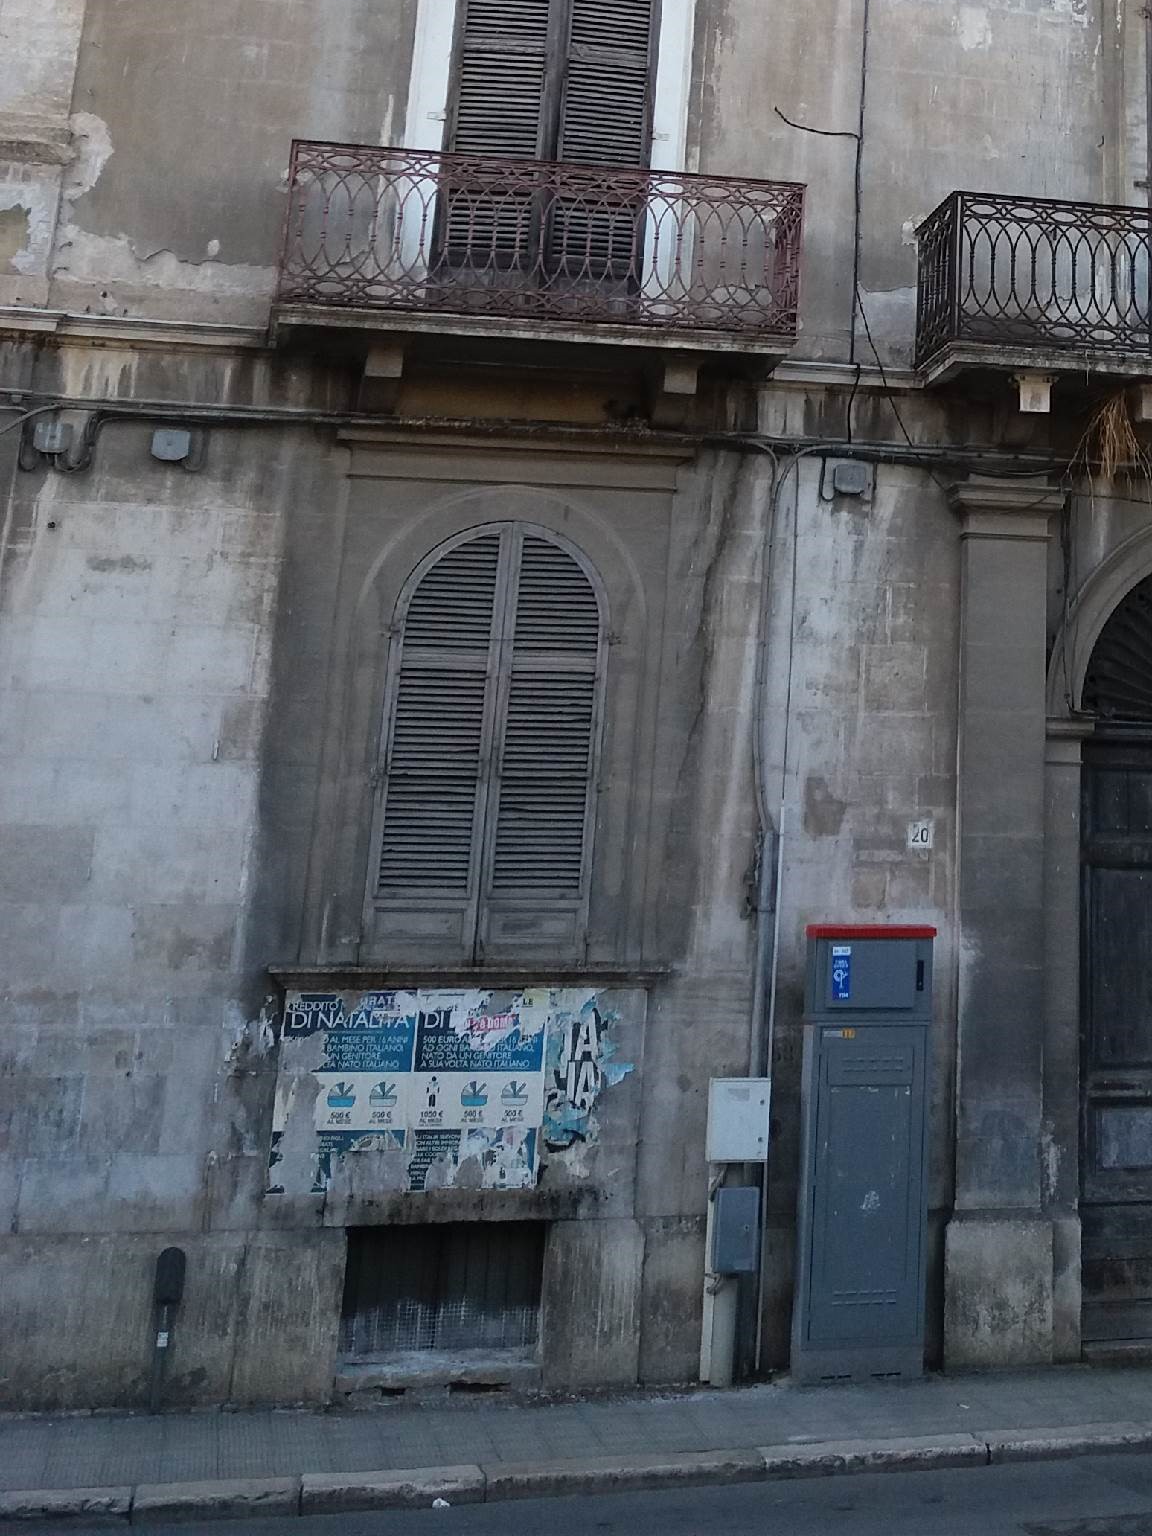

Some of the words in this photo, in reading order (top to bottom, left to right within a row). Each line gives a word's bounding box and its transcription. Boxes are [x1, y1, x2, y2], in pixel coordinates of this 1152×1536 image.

[911, 826, 929, 843] 20
[290, 1011, 312, 1029] DI
[424, 1011, 445, 1029] DI
[423, 1035, 437, 1044] 500
[438, 1035, 461, 1044] EURO
[326, 1043, 364, 1052] BAMBINO
[422, 1044, 434, 1052] AD
[436, 1044, 458, 1052] OGNI
[341, 1052, 381, 1060] GENITORE
[422, 1052, 445, 1060] NATO
[446, 1052, 458, 1060] DA
[460, 1052, 473, 1060] UN
[474, 1052, 512, 1060] GENITORE
[338, 1060, 361, 1068] NATO
[362, 1060, 400, 1068] ITALIANO
[428, 1060, 445, 1068] SUA
[445, 1060, 469, 1068] VOLTA
[470, 1060, 493, 1068] NATO
[494, 1060, 530, 1068] ITALIANO
